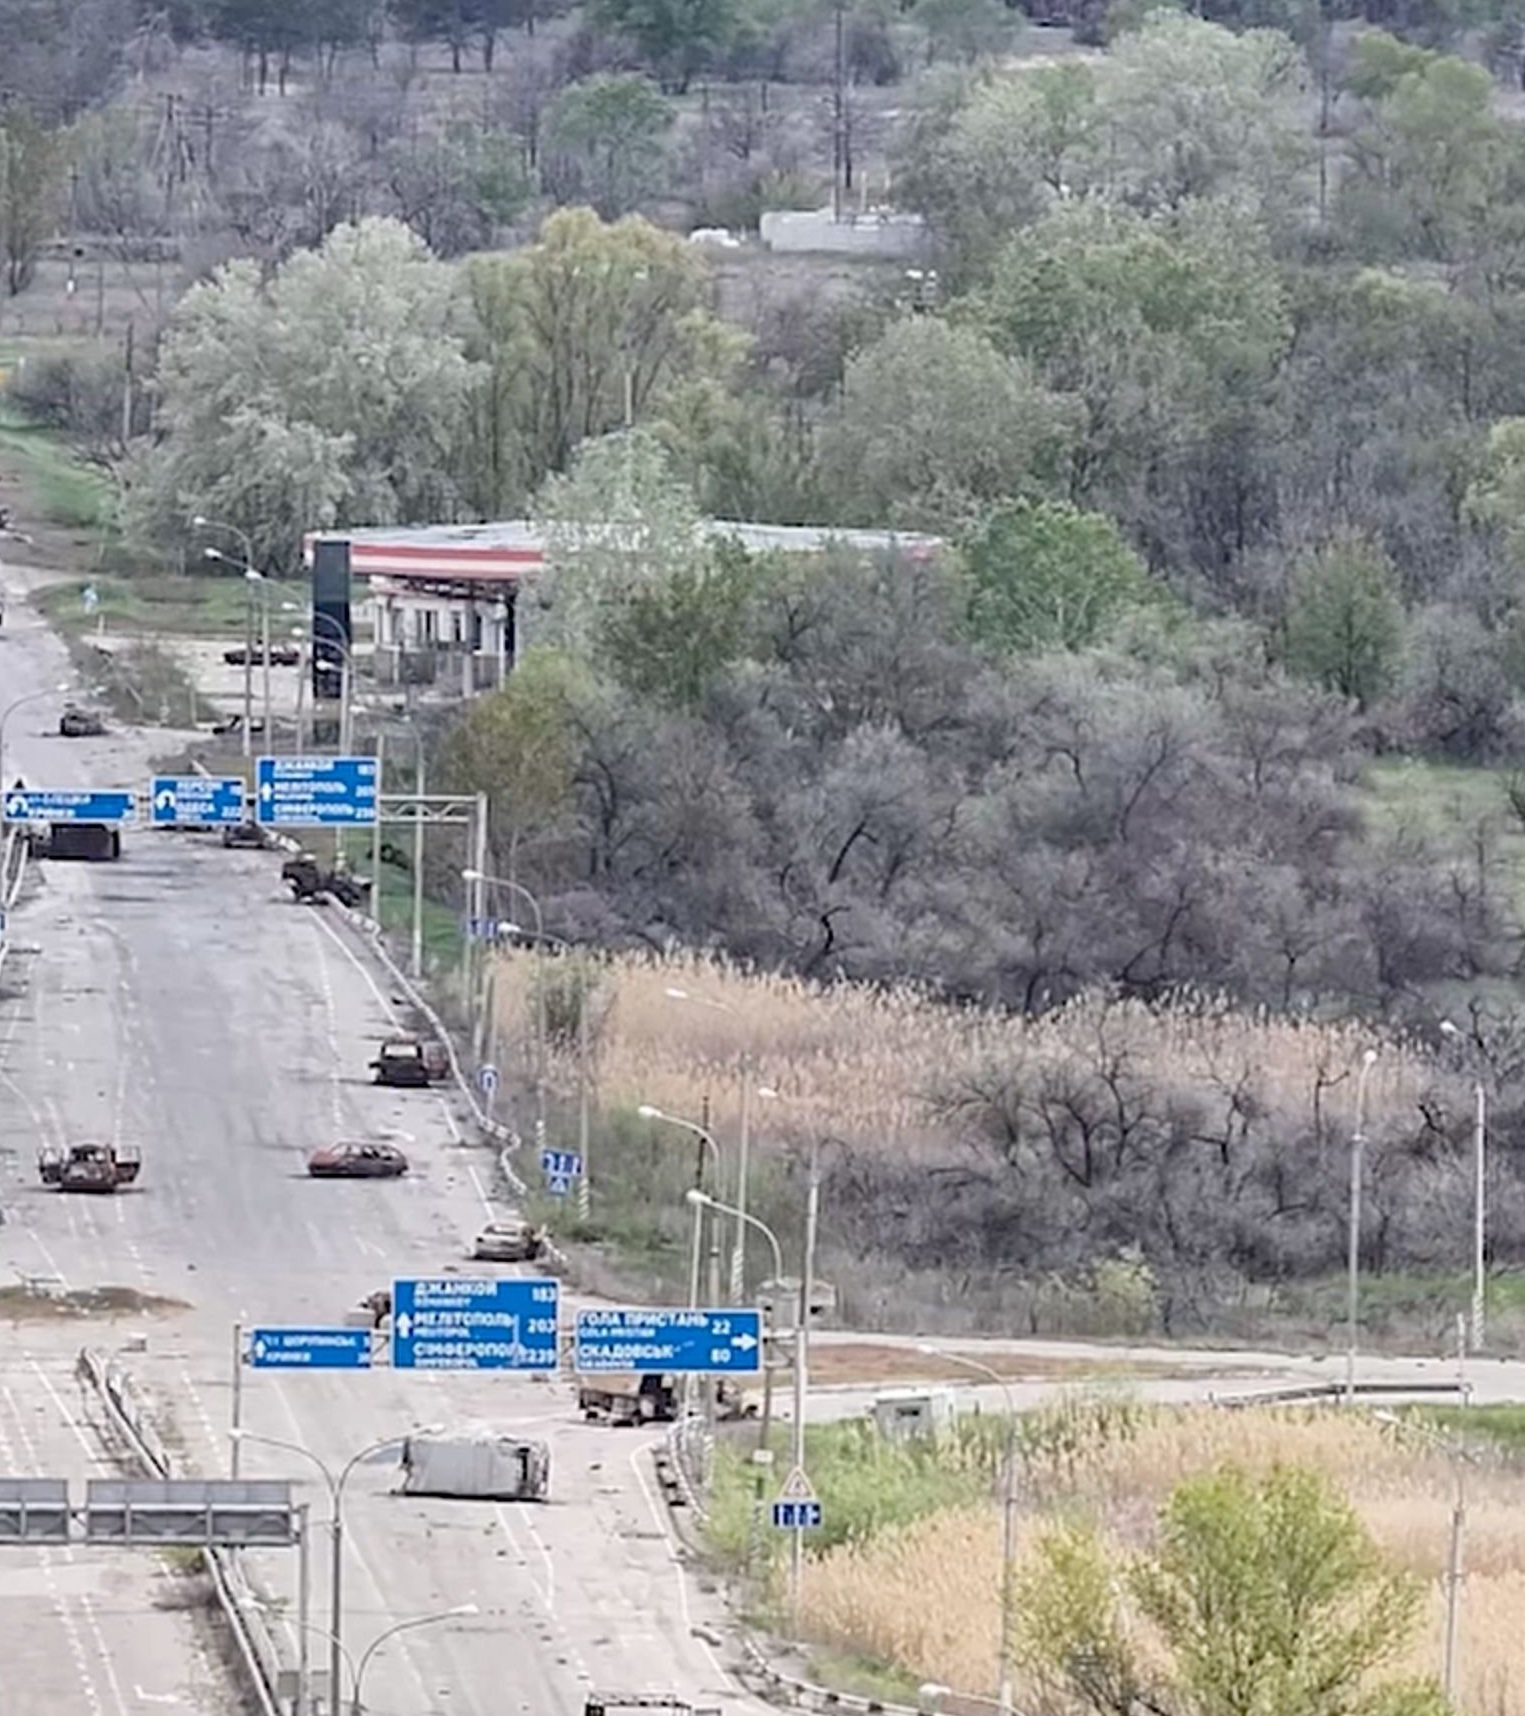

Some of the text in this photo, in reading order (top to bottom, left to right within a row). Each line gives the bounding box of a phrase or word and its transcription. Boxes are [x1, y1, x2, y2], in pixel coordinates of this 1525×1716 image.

[414, 1280, 557, 1303] ДЖАНКОЙ 183
[413, 1311, 557, 1334] МЕЛІТОПОЛЬ 203
[579, 1311, 732, 1335] ГОЛА ПРИСТАНЬ 22
[579, 1343, 732, 1364] СКАДОВСЬК 80
